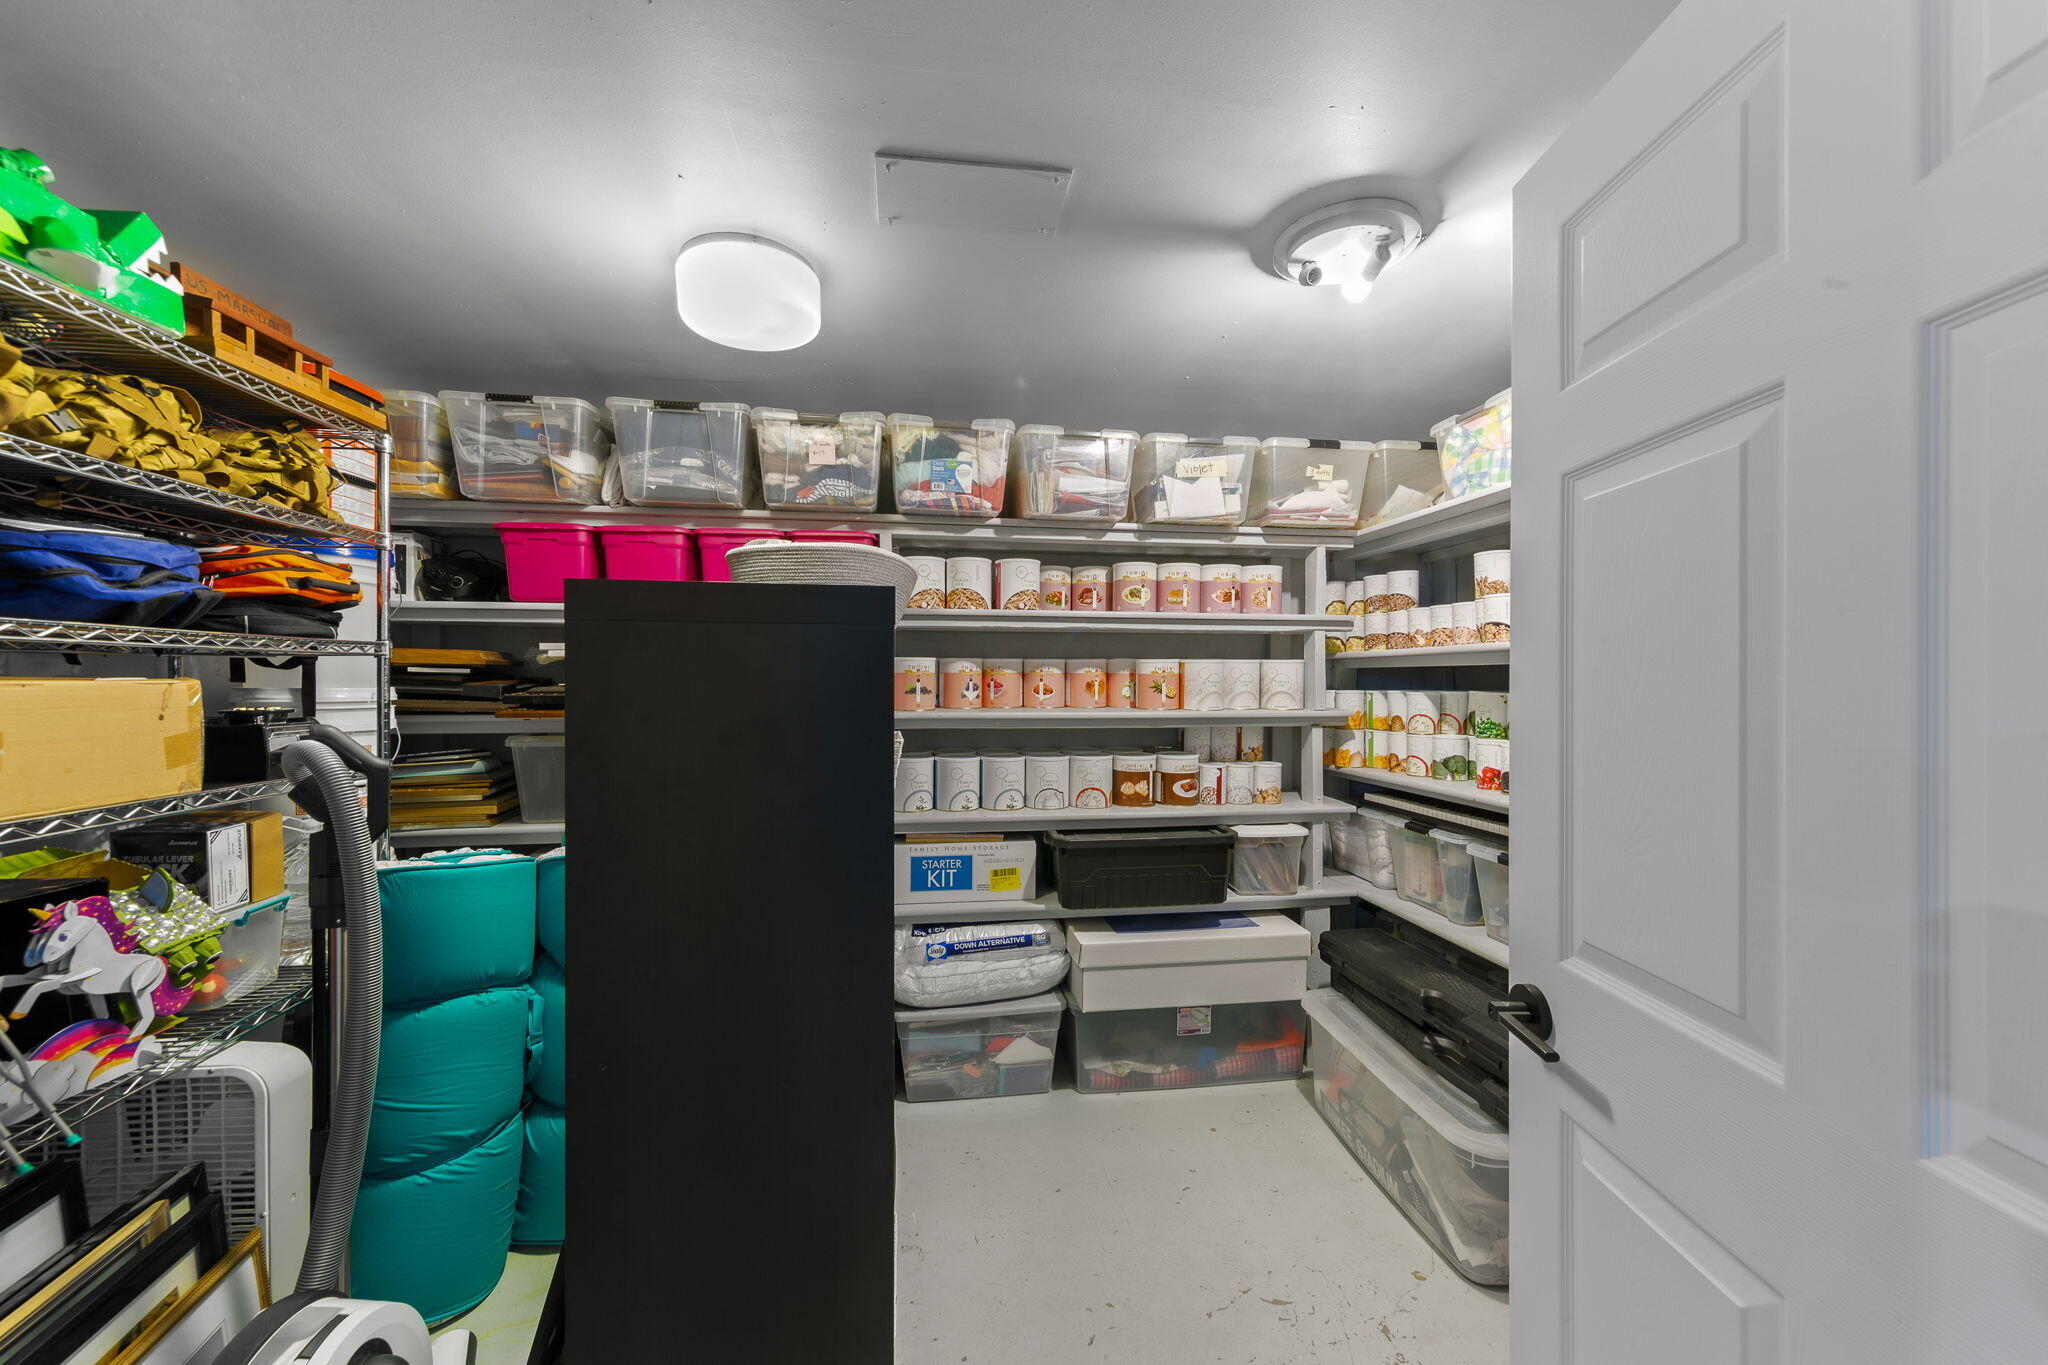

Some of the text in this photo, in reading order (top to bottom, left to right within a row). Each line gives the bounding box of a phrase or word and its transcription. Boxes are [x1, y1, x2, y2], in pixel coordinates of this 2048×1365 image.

[186, 273, 208, 295] US
[1183, 463, 1214, 475] Violet
[123, 855, 194, 863] TUBULAR LEVER
[921, 859, 962, 869] STARTER
[927, 869, 958, 888] KIT
[954, 942, 977, 950] DOWN
[977, 936, 1026, 948] ALTERNATIVE
[929, 946, 945, 956] Sealy
